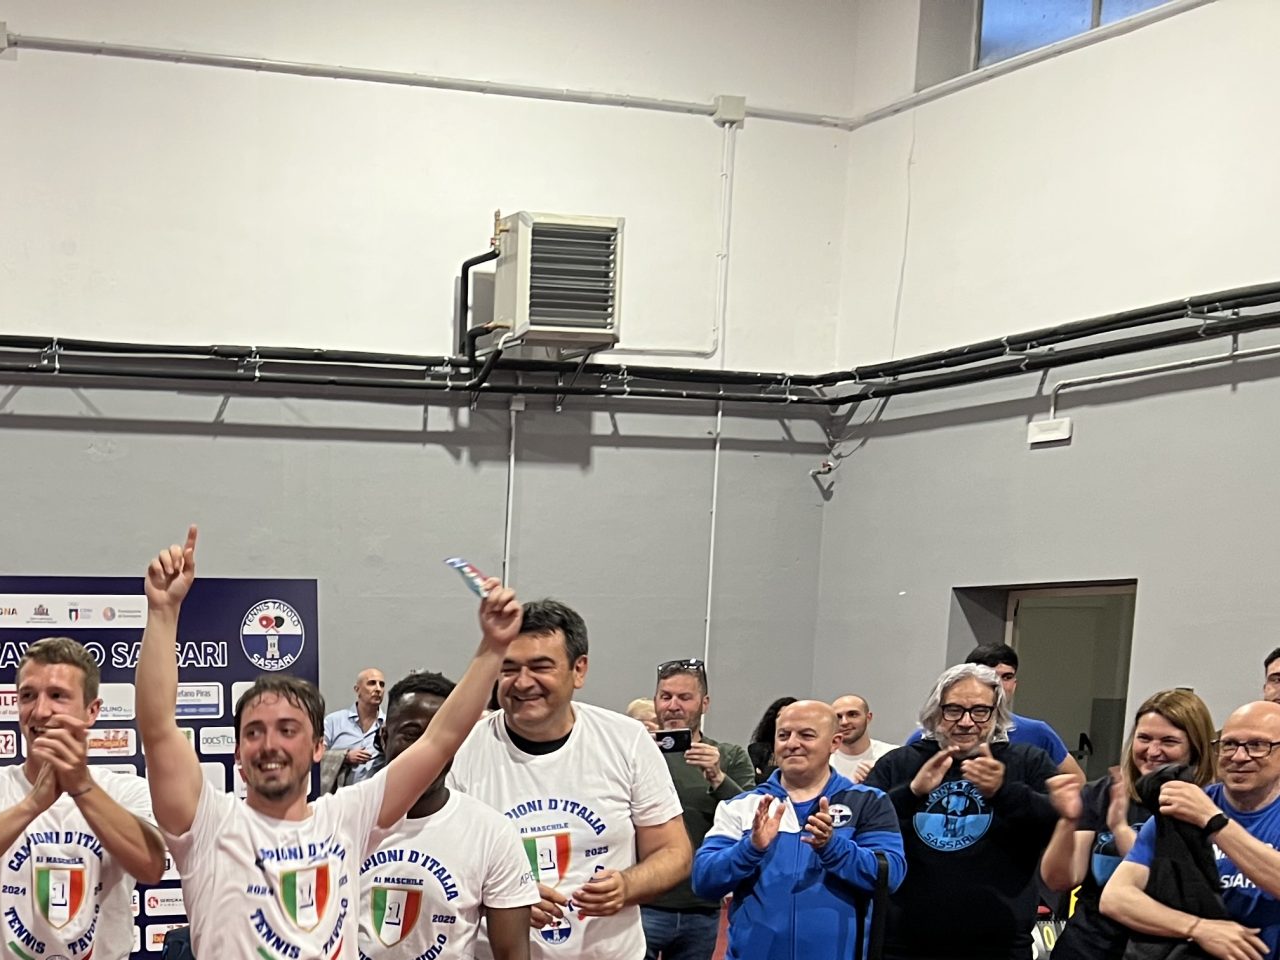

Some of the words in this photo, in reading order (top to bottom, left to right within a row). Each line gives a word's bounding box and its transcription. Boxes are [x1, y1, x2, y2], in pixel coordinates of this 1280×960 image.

[244, 603, 270, 627] TENNIS
[273, 603, 300, 627] TAVOLO
[111, 641, 228, 669] SAARI
[251, 653, 295, 670] SASSARI
[178, 689, 195, 698] efano
[548, 798, 607, 836] D'ITALIA
[530, 822, 569, 833] MASCHILE
[924, 832, 975, 848] SASSARI
[584, 845, 609, 858] 2025
[384, 876, 424, 886] MASCHILE
[407, 849, 459, 902] D'ITALIA
[1, 884, 27, 897] 2024
[4, 906, 46, 955] TENNIS
[249, 907, 301, 960] TENNIS
[322, 897, 349, 955] TAVOLO
